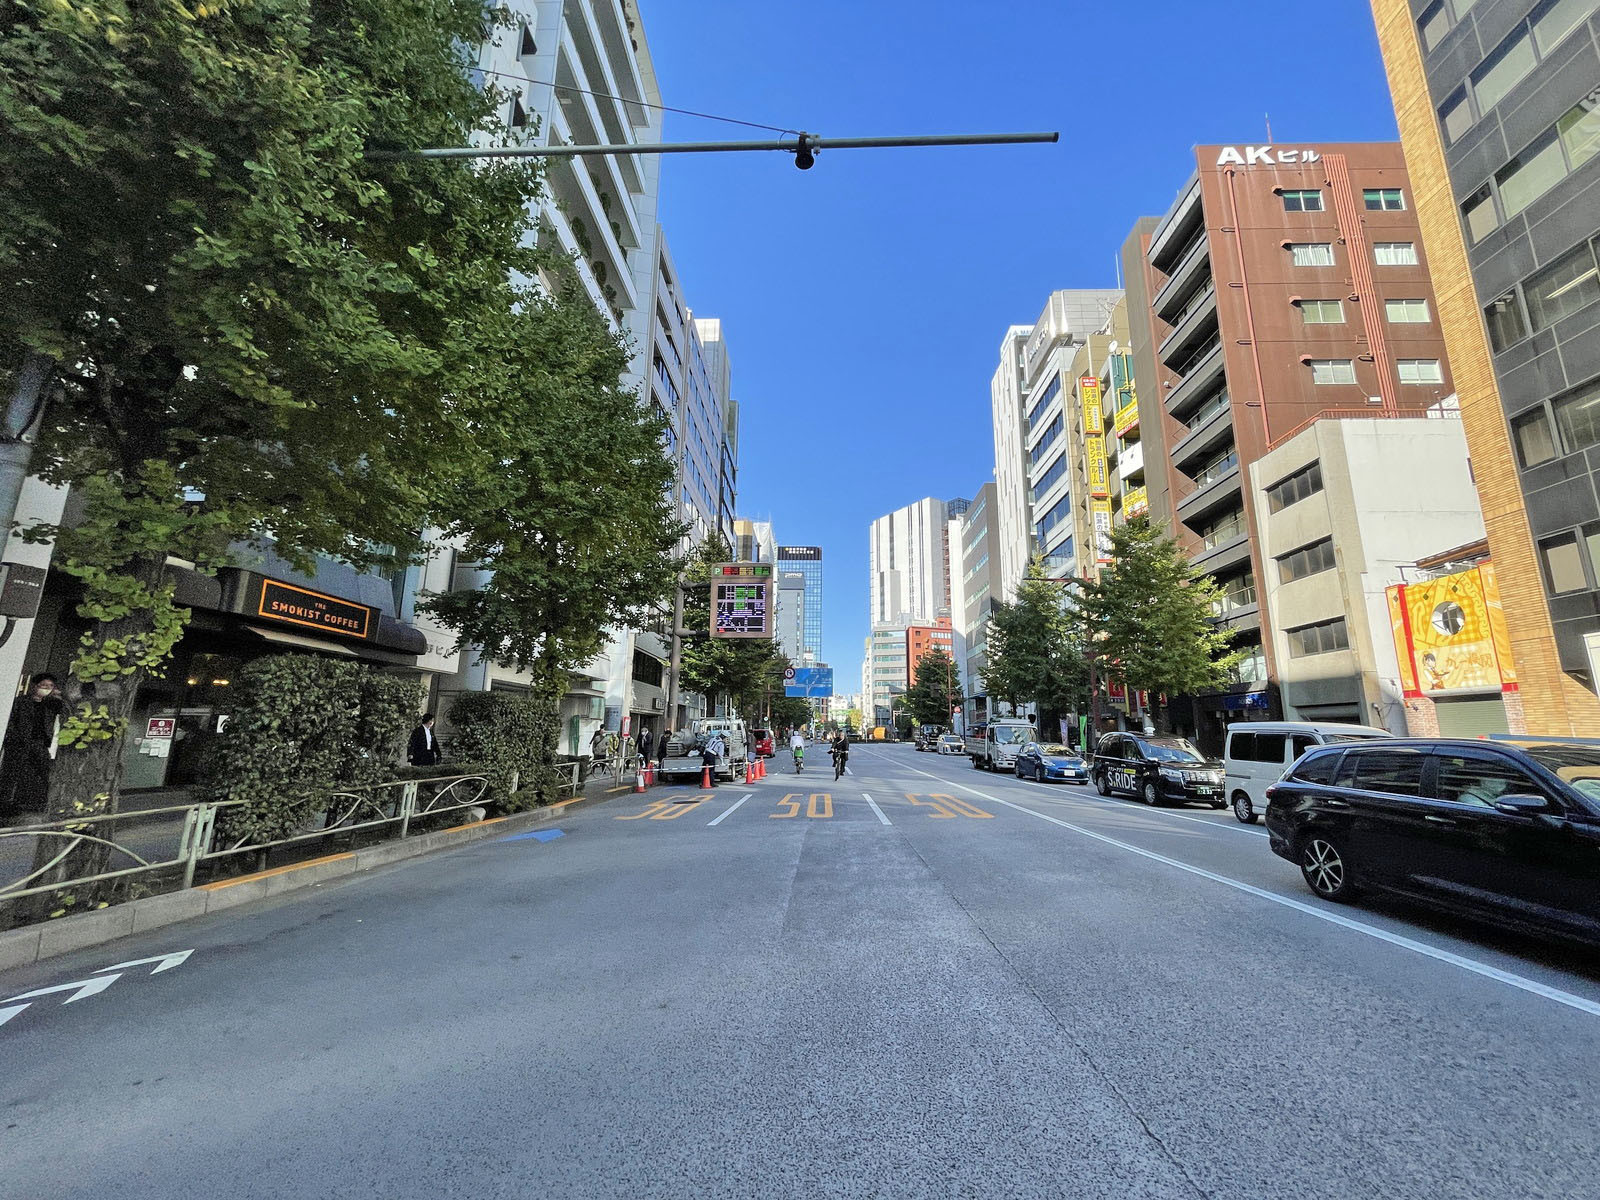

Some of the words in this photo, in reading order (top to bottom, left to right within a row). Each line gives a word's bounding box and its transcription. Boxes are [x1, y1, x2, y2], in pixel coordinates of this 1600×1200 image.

[1216, 146, 1320, 166] AKビル
[271, 600, 321, 619] SMOKIST
[324, 613, 360, 629] COFFEE
[314, 602, 327, 610] THE
[769, 793, 834, 819] 50
[904, 793, 996, 819] 50
